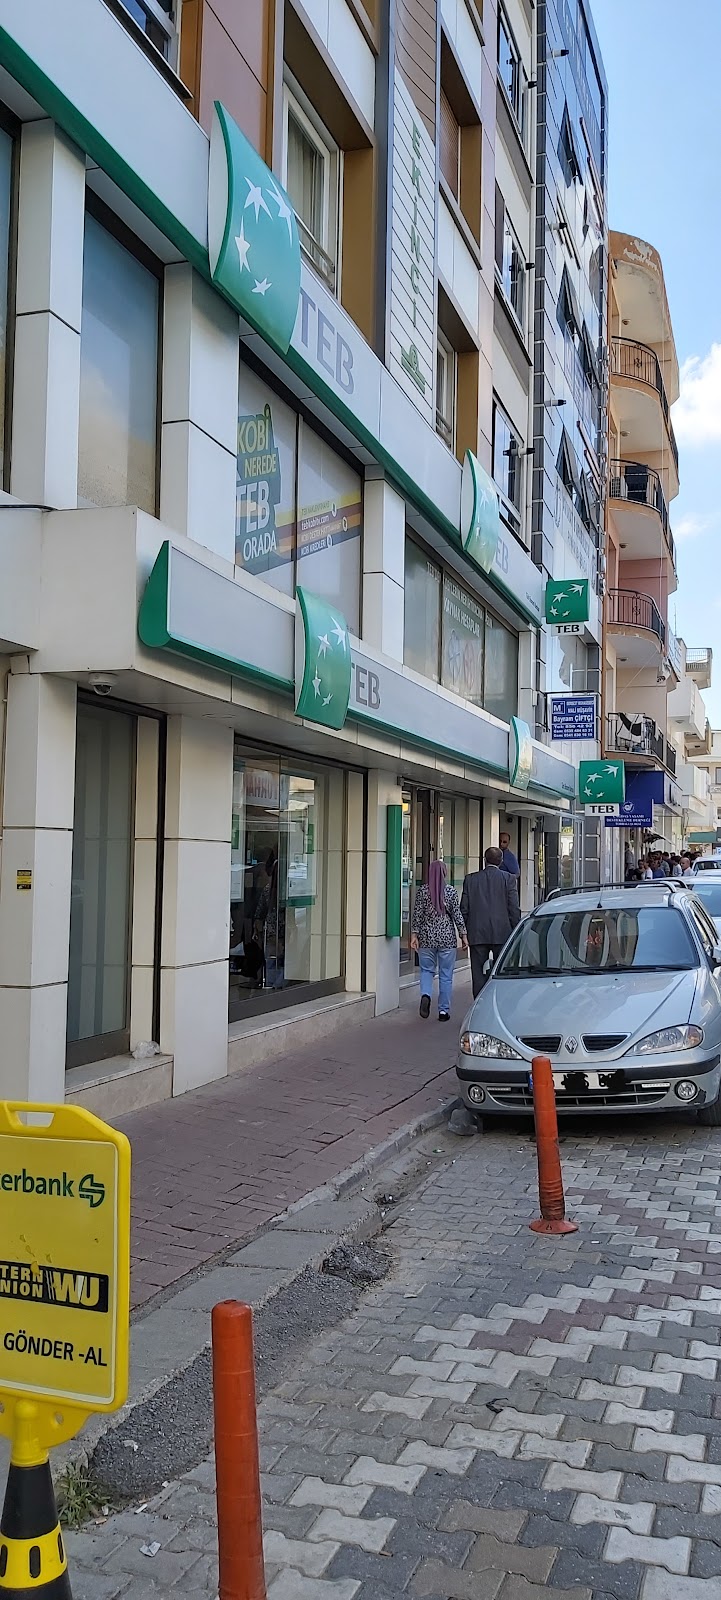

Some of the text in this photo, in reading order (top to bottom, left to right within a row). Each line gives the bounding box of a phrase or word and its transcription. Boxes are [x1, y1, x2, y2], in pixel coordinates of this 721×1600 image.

[299, 287, 355, 395] TEB
[244, 453, 277, 479] NEREDE
[236, 480, 270, 537] TEB
[243, 530, 278, 562] ORADA
[555, 624, 580, 634] TEB
[351, 662, 380, 710] EB
[553, 713, 593, 723] Bayram ÇİFTÇİ
[589, 805, 614, 814] TEB
[0, 1168, 75, 1198] erbank
[3, 1329, 74, 1361] GÖNDER
